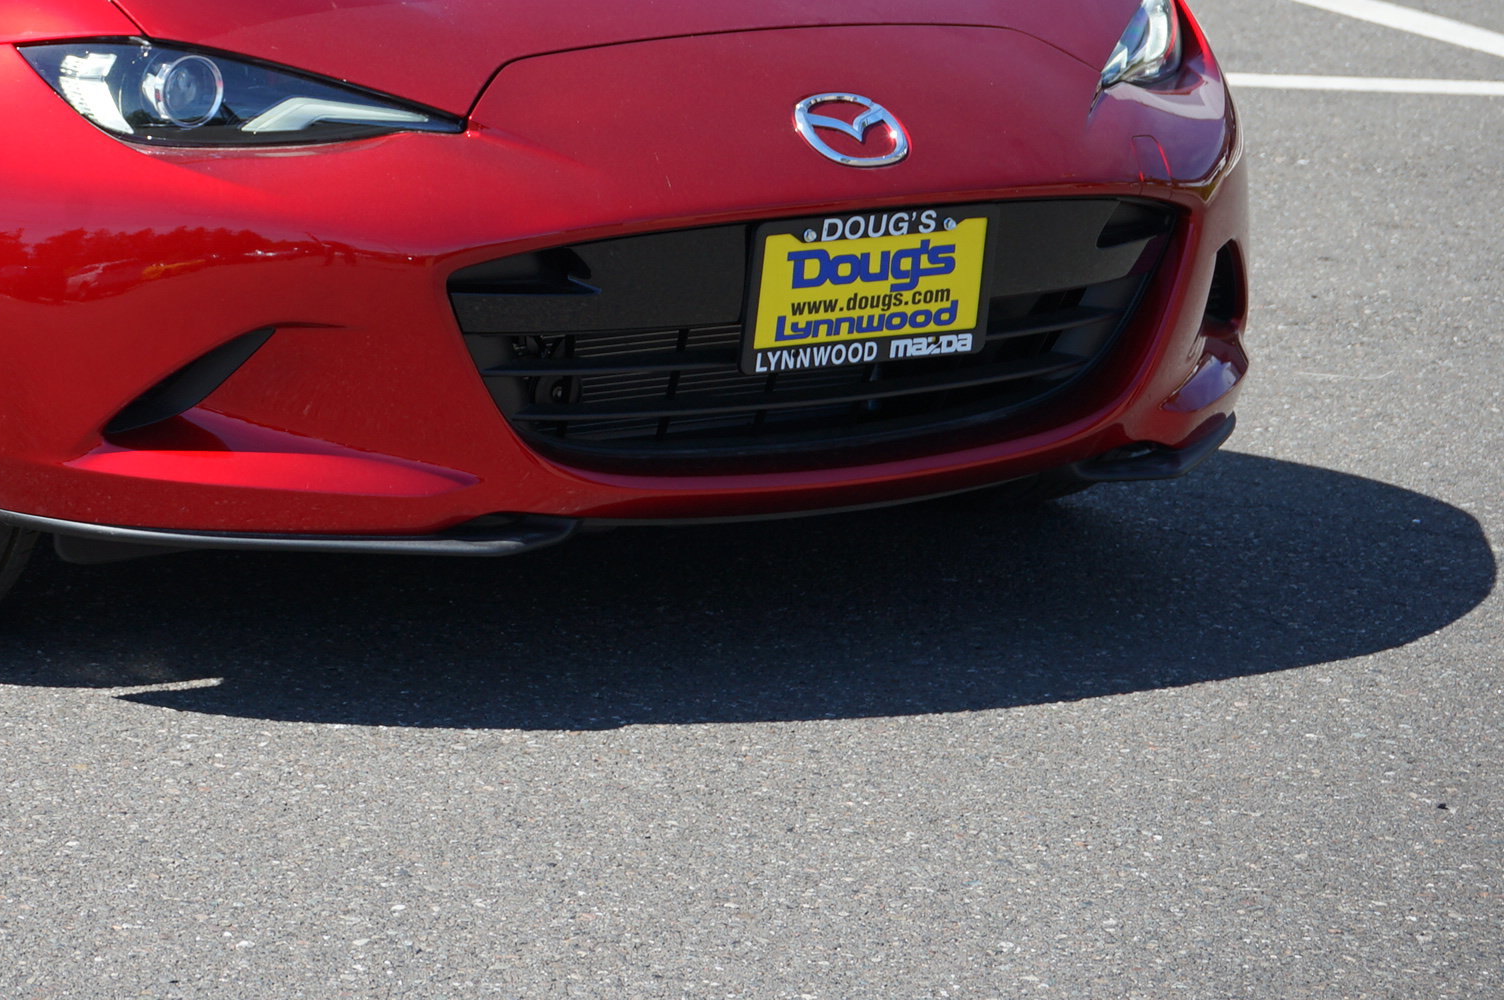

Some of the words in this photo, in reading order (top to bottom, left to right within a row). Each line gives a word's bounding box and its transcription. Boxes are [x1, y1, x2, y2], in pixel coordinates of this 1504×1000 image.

[821, 209, 937, 242] DOUG'S
[787, 239, 956, 292] Doug's
[791, 288, 951, 317] www.dougs.com
[774, 300, 959, 342] Lynnwood
[755, 341, 878, 372] LYNNWOOD
